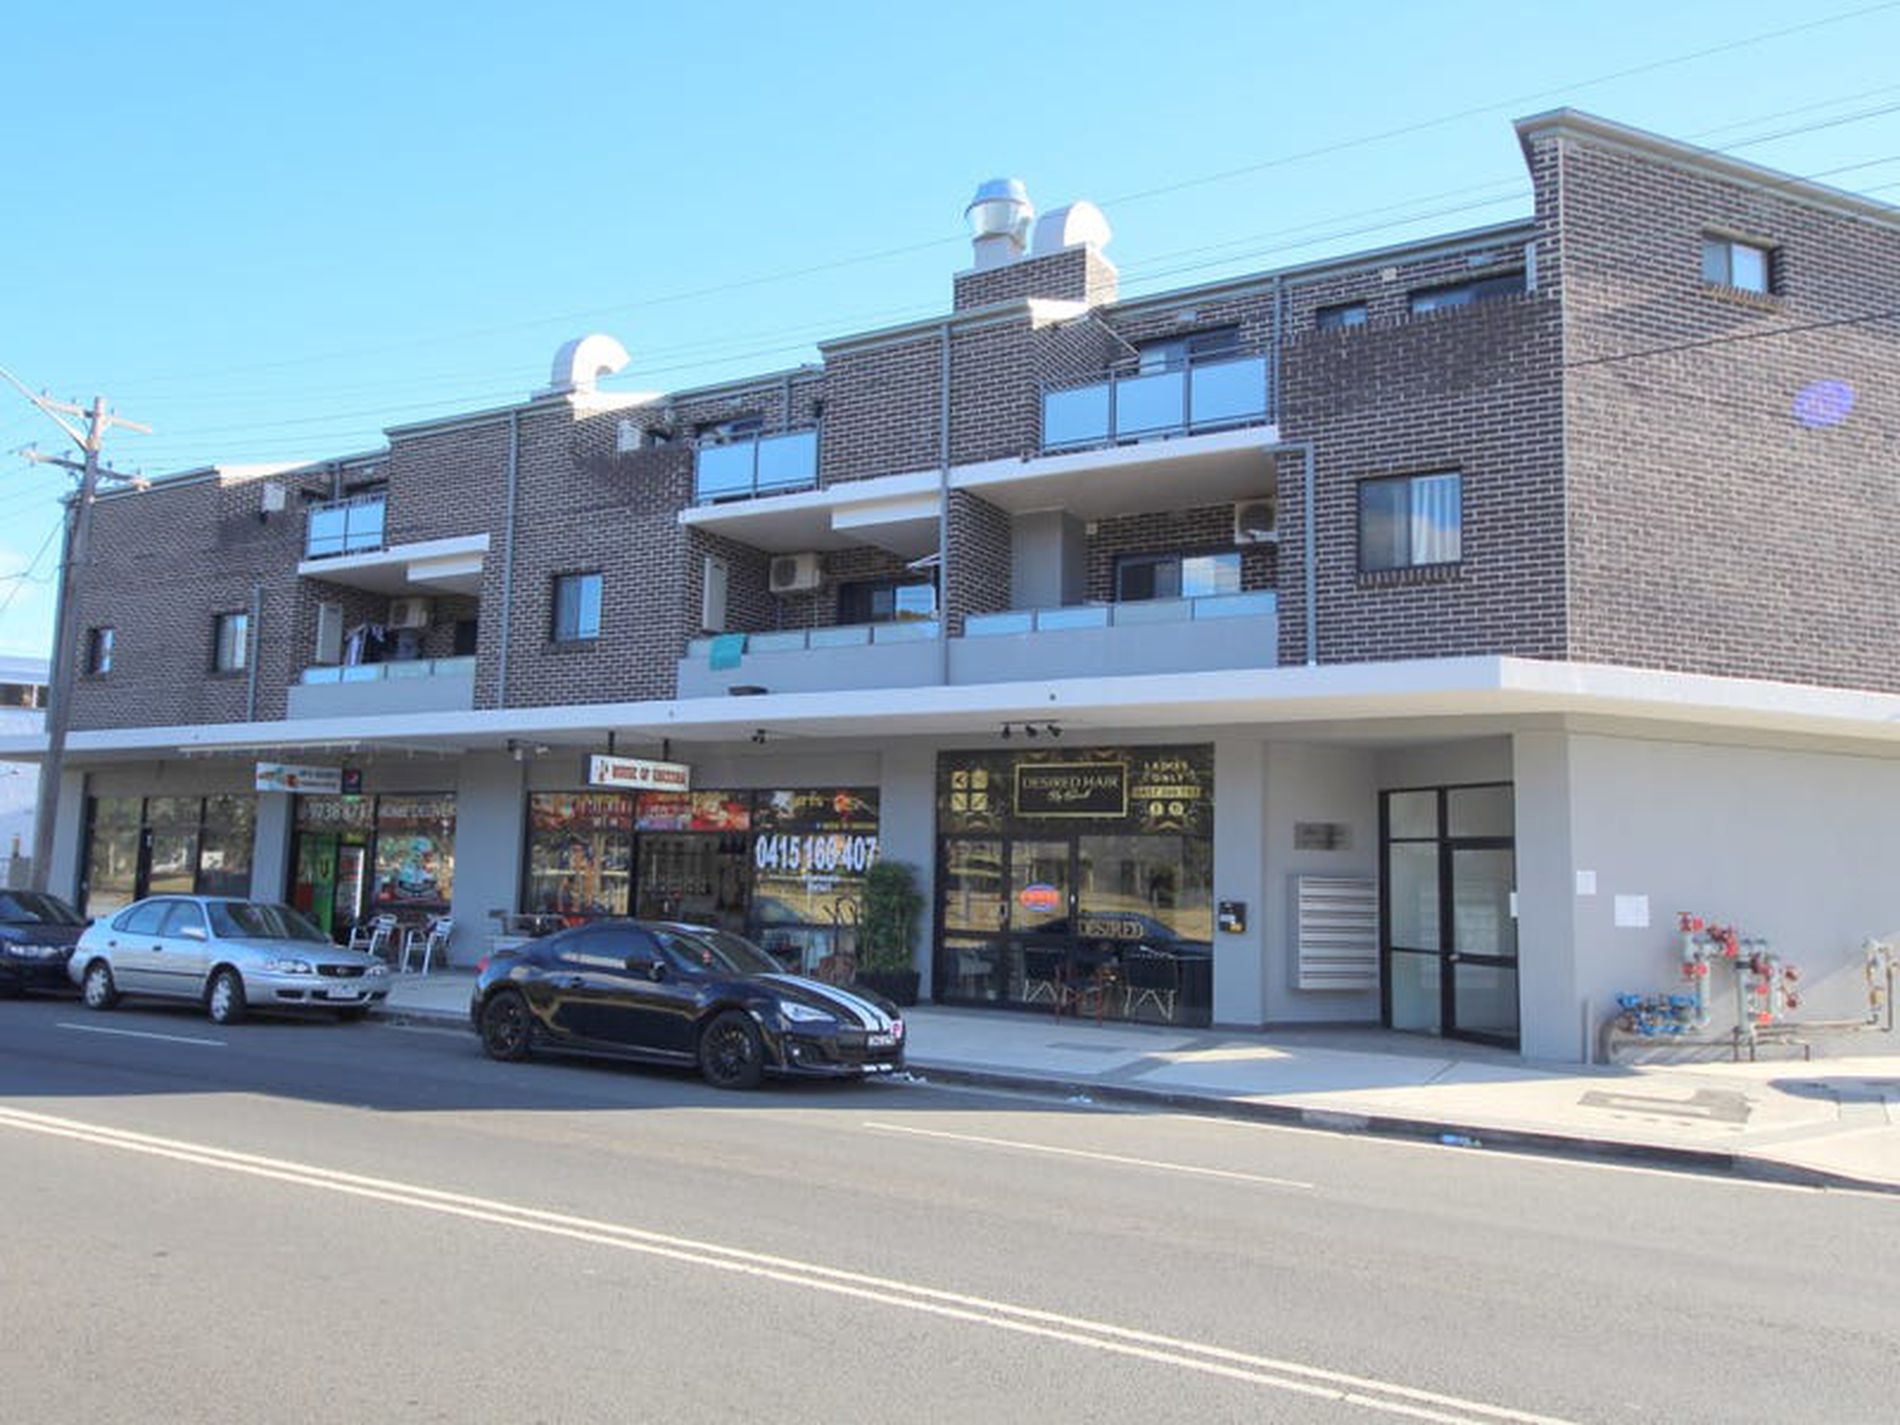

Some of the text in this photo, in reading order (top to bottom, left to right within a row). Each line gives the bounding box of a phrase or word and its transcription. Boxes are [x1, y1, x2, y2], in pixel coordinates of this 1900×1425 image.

[1022, 777, 1081, 789] DESIRED
[755, 834, 800, 869] 0415
[842, 835, 877, 872] 407
